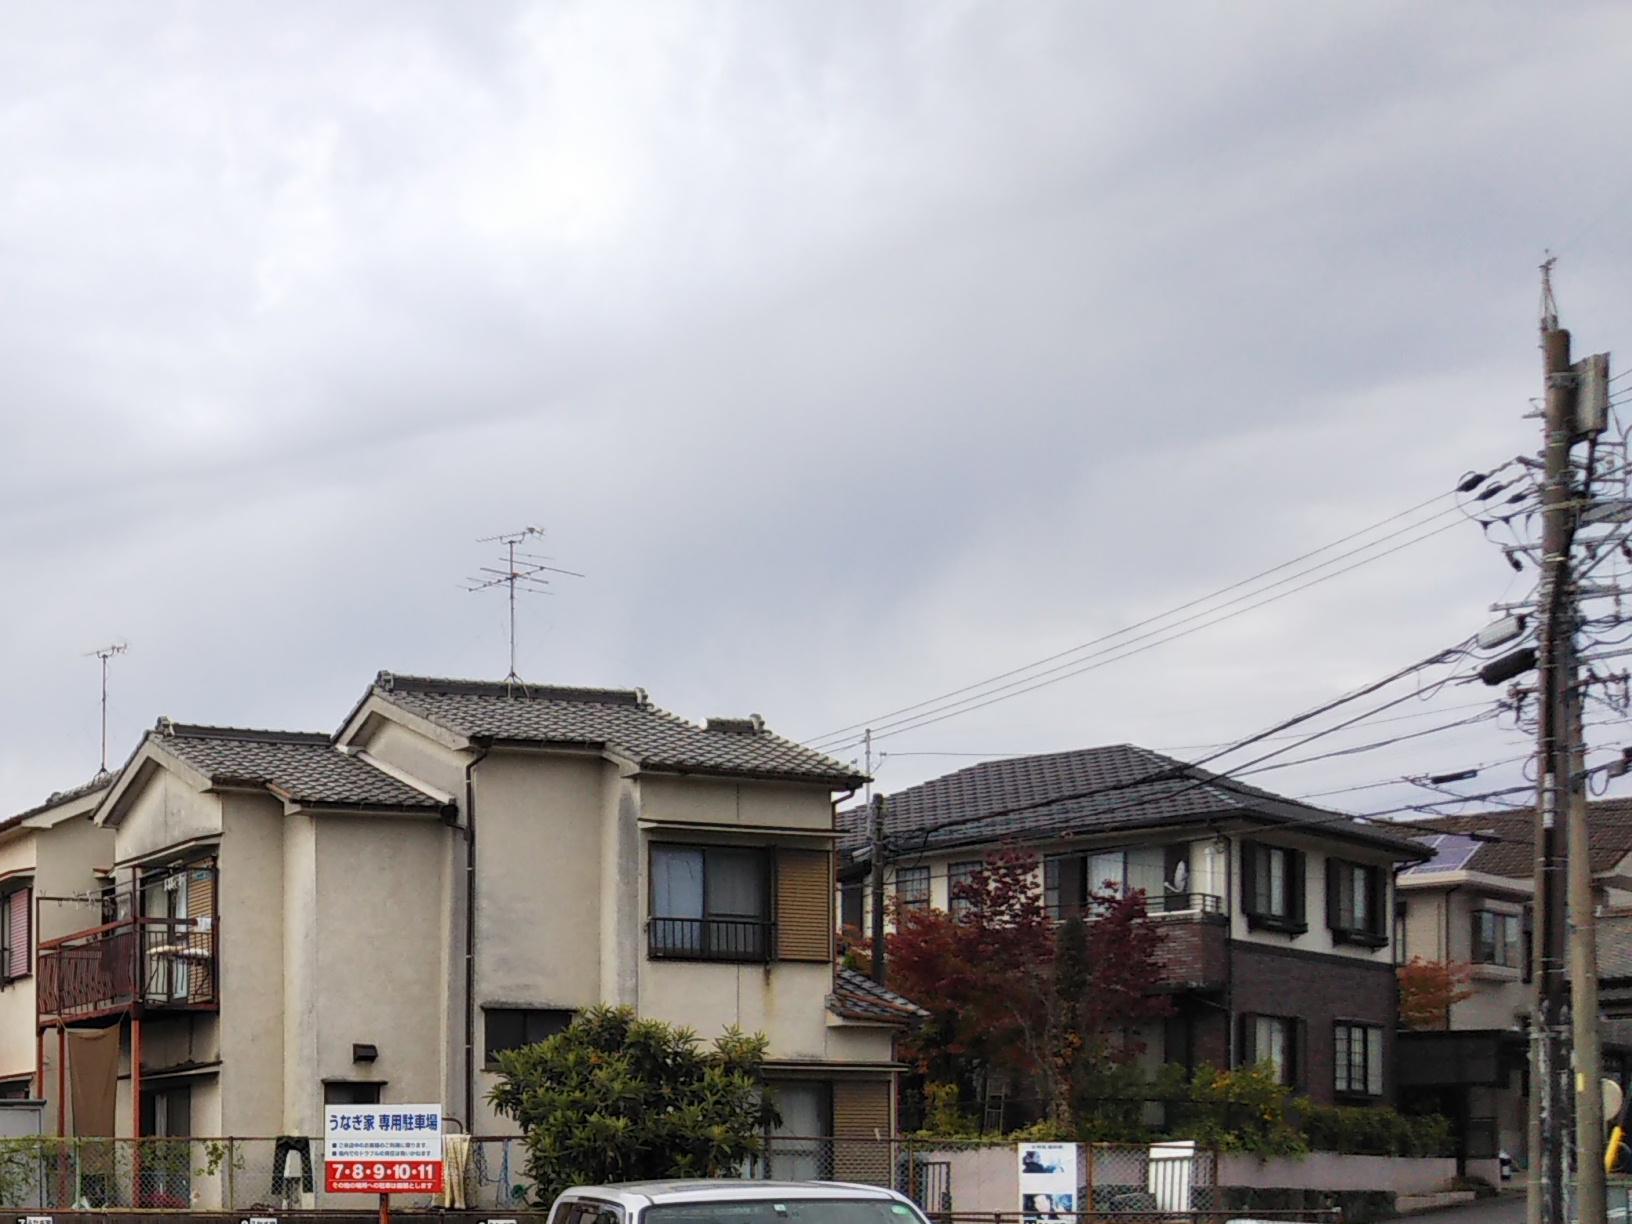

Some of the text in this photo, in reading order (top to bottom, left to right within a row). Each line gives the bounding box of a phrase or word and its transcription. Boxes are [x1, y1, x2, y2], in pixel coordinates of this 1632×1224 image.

[329, 1114, 438, 1131] うなぎ家 専用駐車場
